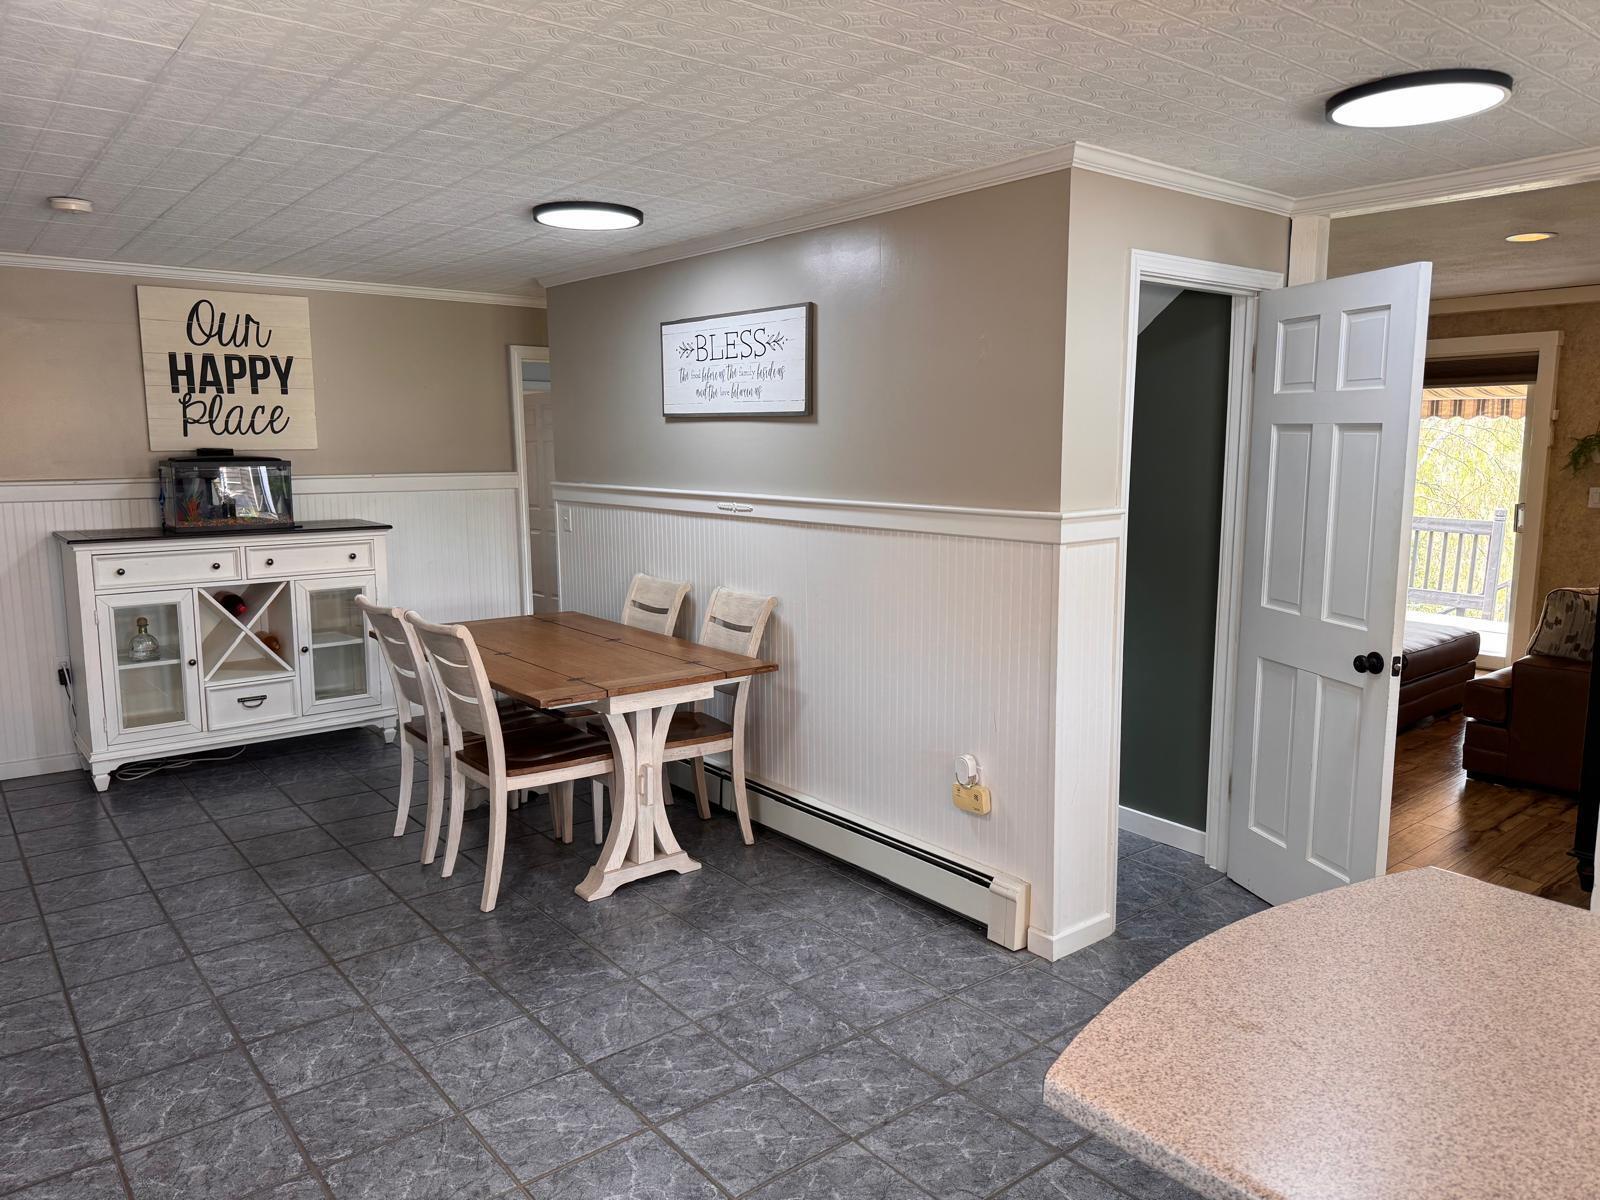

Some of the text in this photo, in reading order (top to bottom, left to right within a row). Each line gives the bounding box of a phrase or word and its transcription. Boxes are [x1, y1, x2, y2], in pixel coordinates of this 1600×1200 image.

[186, 299, 272, 348] Our
[695, 327, 767, 362] BLESS
[168, 351, 294, 395] HAPPY
[701, 367, 718, 382] before
[718, 368, 726, 382] us
[756, 361, 776, 381] beside
[778, 365, 786, 381] us
[730, 382, 753, 399] between
[754, 385, 763, 399] us
